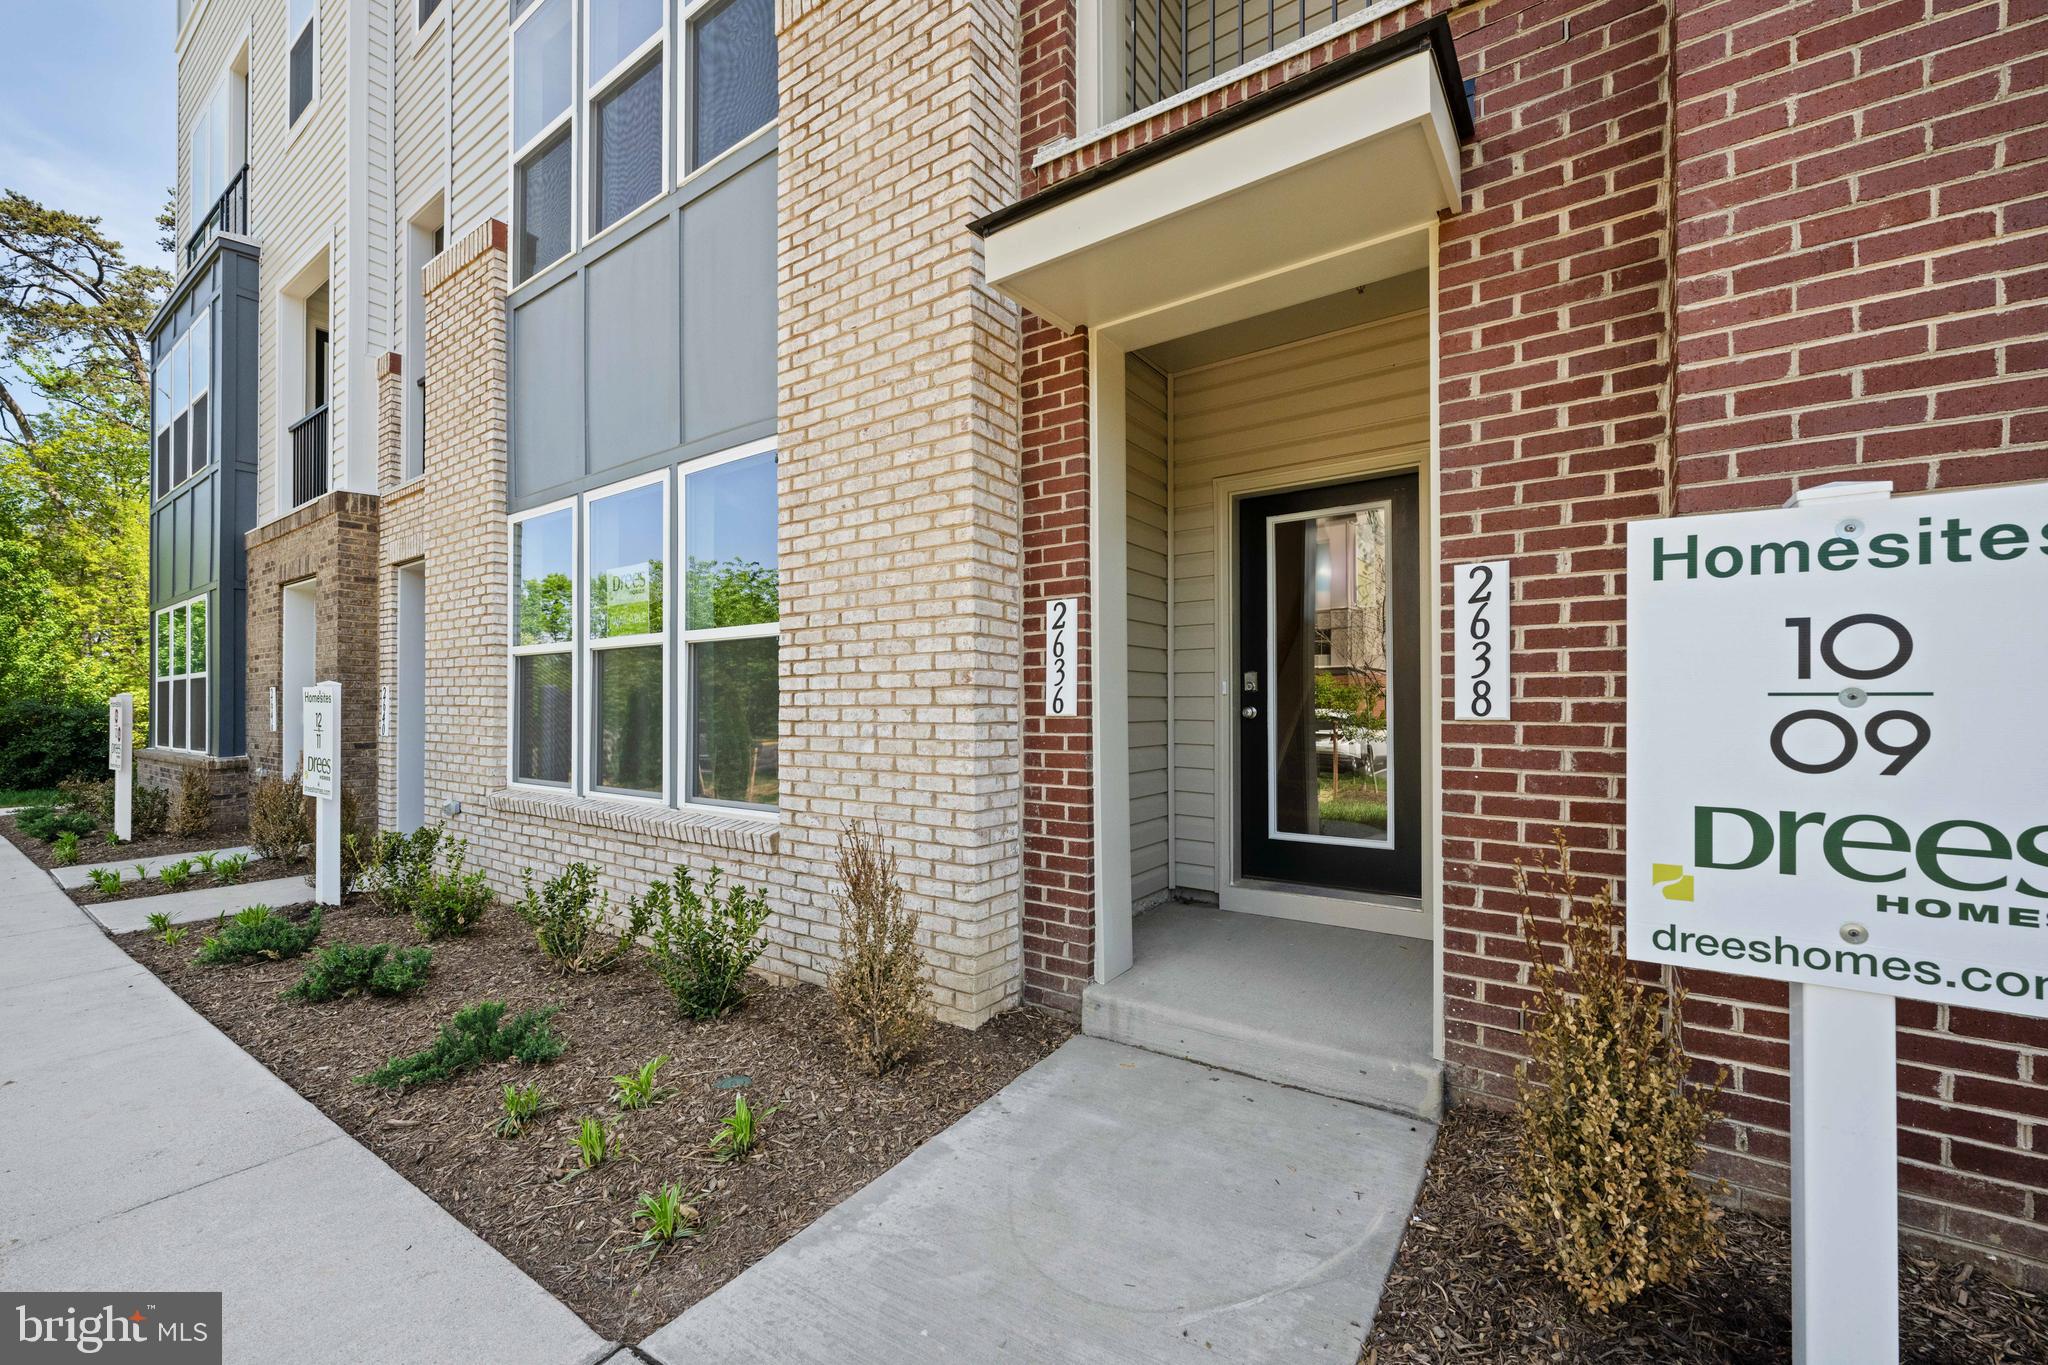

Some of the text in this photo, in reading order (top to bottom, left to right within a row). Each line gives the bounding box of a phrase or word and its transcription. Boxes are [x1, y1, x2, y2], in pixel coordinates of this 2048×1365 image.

[1653, 516, 2048, 581] Homesite
[1052, 601, 1067, 714] 2636
[1468, 565, 1493, 717] 2638
[1785, 613, 1914, 681] 10
[304, 691, 332, 703] Homesites
[315, 712, 322, 728] 12
[307, 755, 331, 775] Drees
[1769, 709, 1932, 776] 09
[1876, 894, 2048, 928] HOME
[1652, 923, 2048, 1001] dreeshomes.co
